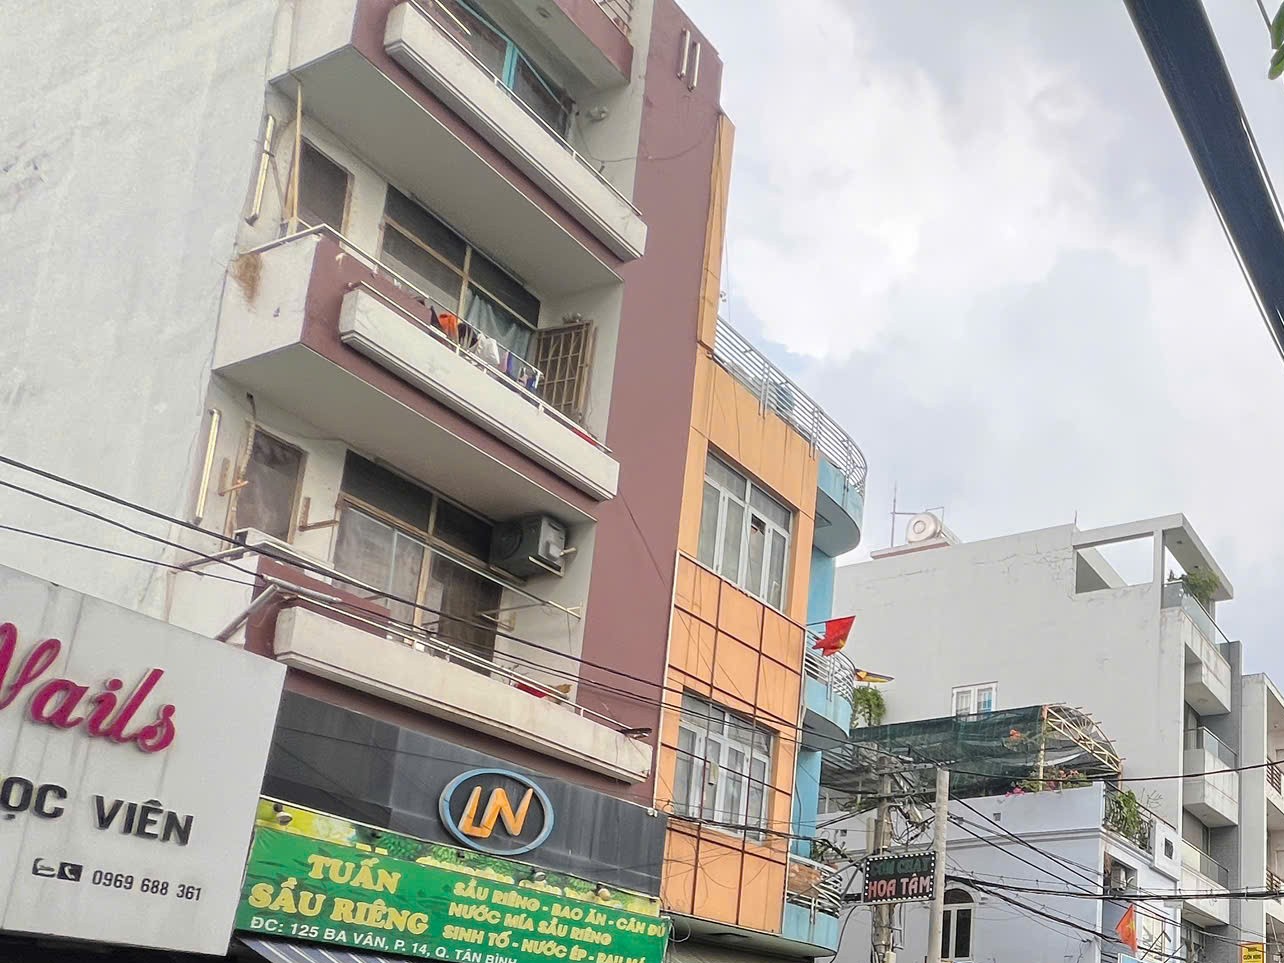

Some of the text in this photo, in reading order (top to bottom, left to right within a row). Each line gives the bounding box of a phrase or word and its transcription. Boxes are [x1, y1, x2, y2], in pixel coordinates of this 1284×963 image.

[95, 795, 194, 846] VIÊN
[92, 870, 202, 901] 0969 688 361
[308, 854, 401, 894] TUẤN
[868, 873, 930, 899] HOA TÂM
[248, 877, 429, 934] SẦU RIÊNG
[448, 902, 501, 924] NƯỚC
[504, 912, 534, 931] MÍA
[570, 927, 612, 946] RIÊNG
[492, 890, 540, 912] RIÊNG
[551, 904, 585, 922] BAO
[250, 916, 284, 933] ĐC:
[290, 923, 319, 938] 125
[323, 930, 347, 942] BA
[353, 931, 389, 950] VÂN,
[394, 940, 406, 952] P.
[412, 943, 431, 958] 14,
[435, 946, 449, 960] Q.
[455, 948, 482, 963] TÂN
[442, 924, 484, 943] SINH
[487, 930, 513, 948] TỐ
[521, 938, 568, 958] NƯỚC
[569, 945, 588, 962] ÉP
